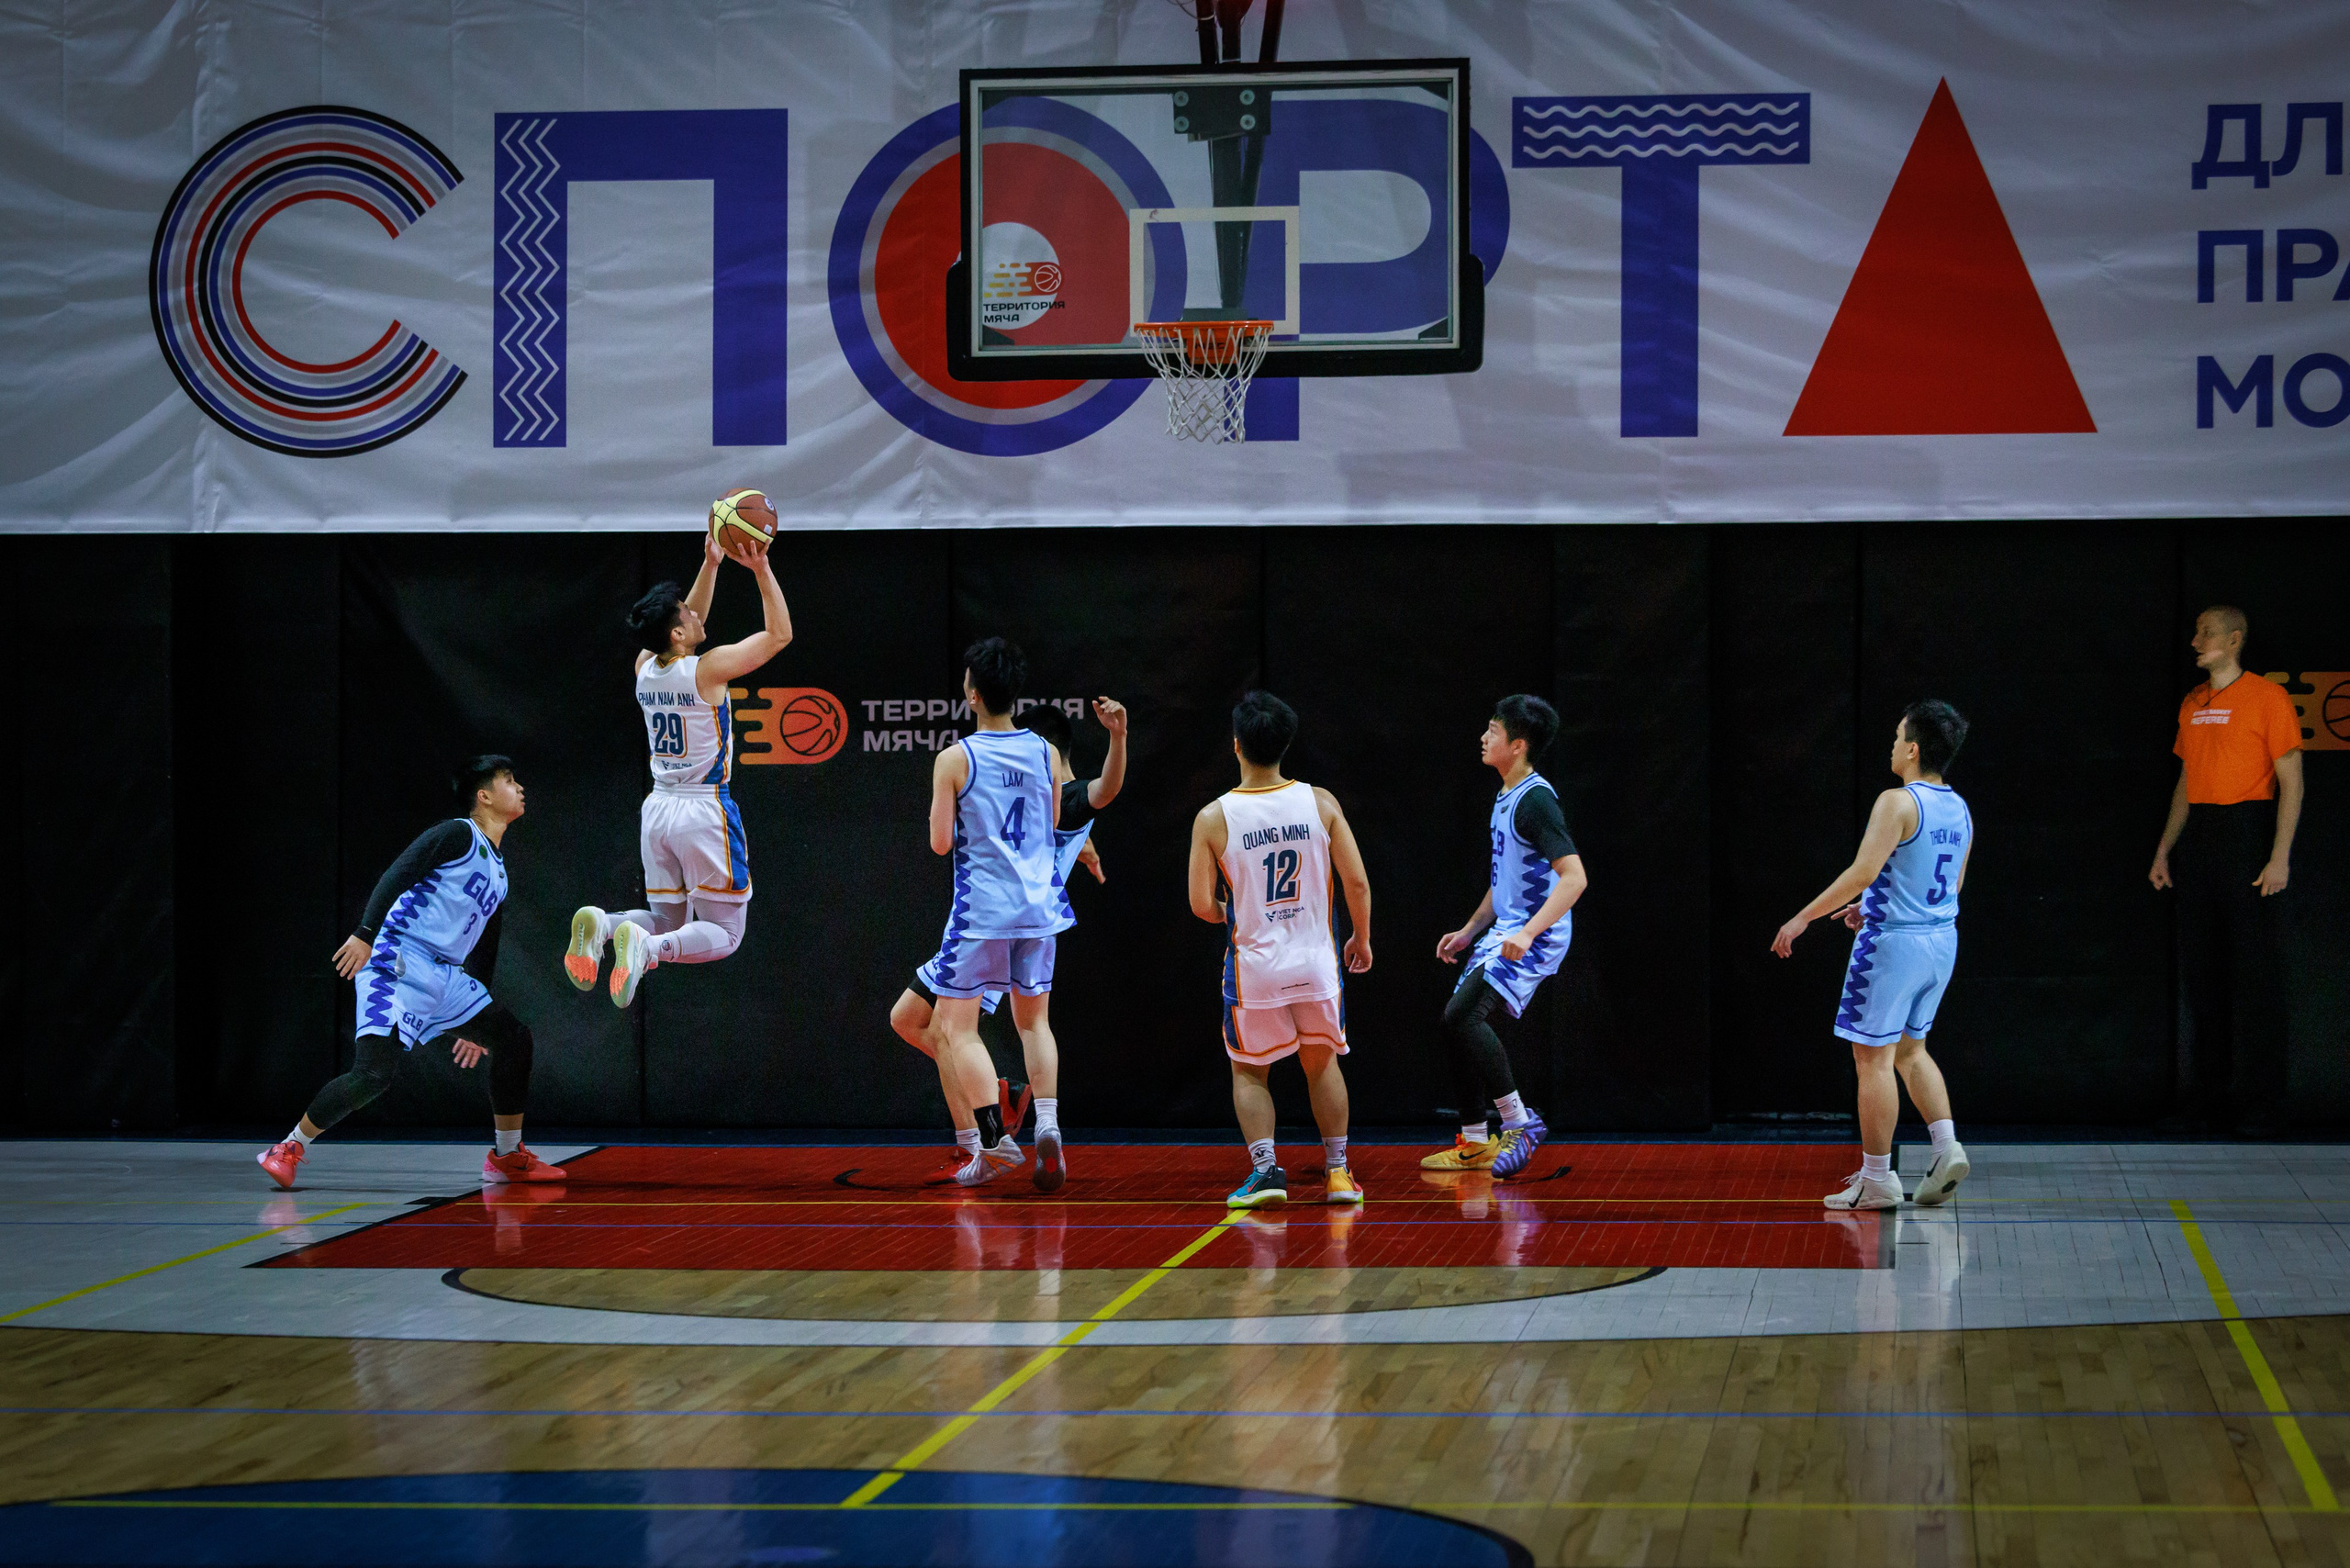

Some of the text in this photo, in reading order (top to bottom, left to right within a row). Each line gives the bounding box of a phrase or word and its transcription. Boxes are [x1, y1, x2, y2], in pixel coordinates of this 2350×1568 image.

[2191, 102, 2350, 189] ДЛ
[2198, 229, 2350, 303] ПР
[983, 301, 1065, 312] ТЕРРИТОРИЯ
[984, 314, 1019, 323] МЯЧА
[657, 691, 674, 706] NAM
[677, 693, 695, 706] ANH
[653, 712, 688, 758] 29
[2190, 716, 2231, 725] REFEREE
[1000, 797, 1025, 850] 4
[1243, 824, 1310, 850] QUANG MINH
[463, 871, 498, 916] GLB
[1262, 849, 1302, 906] 12
[1926, 854, 1953, 905] 5
[464, 913, 477, 935] 3
[402, 1012, 424, 1031] GLB
